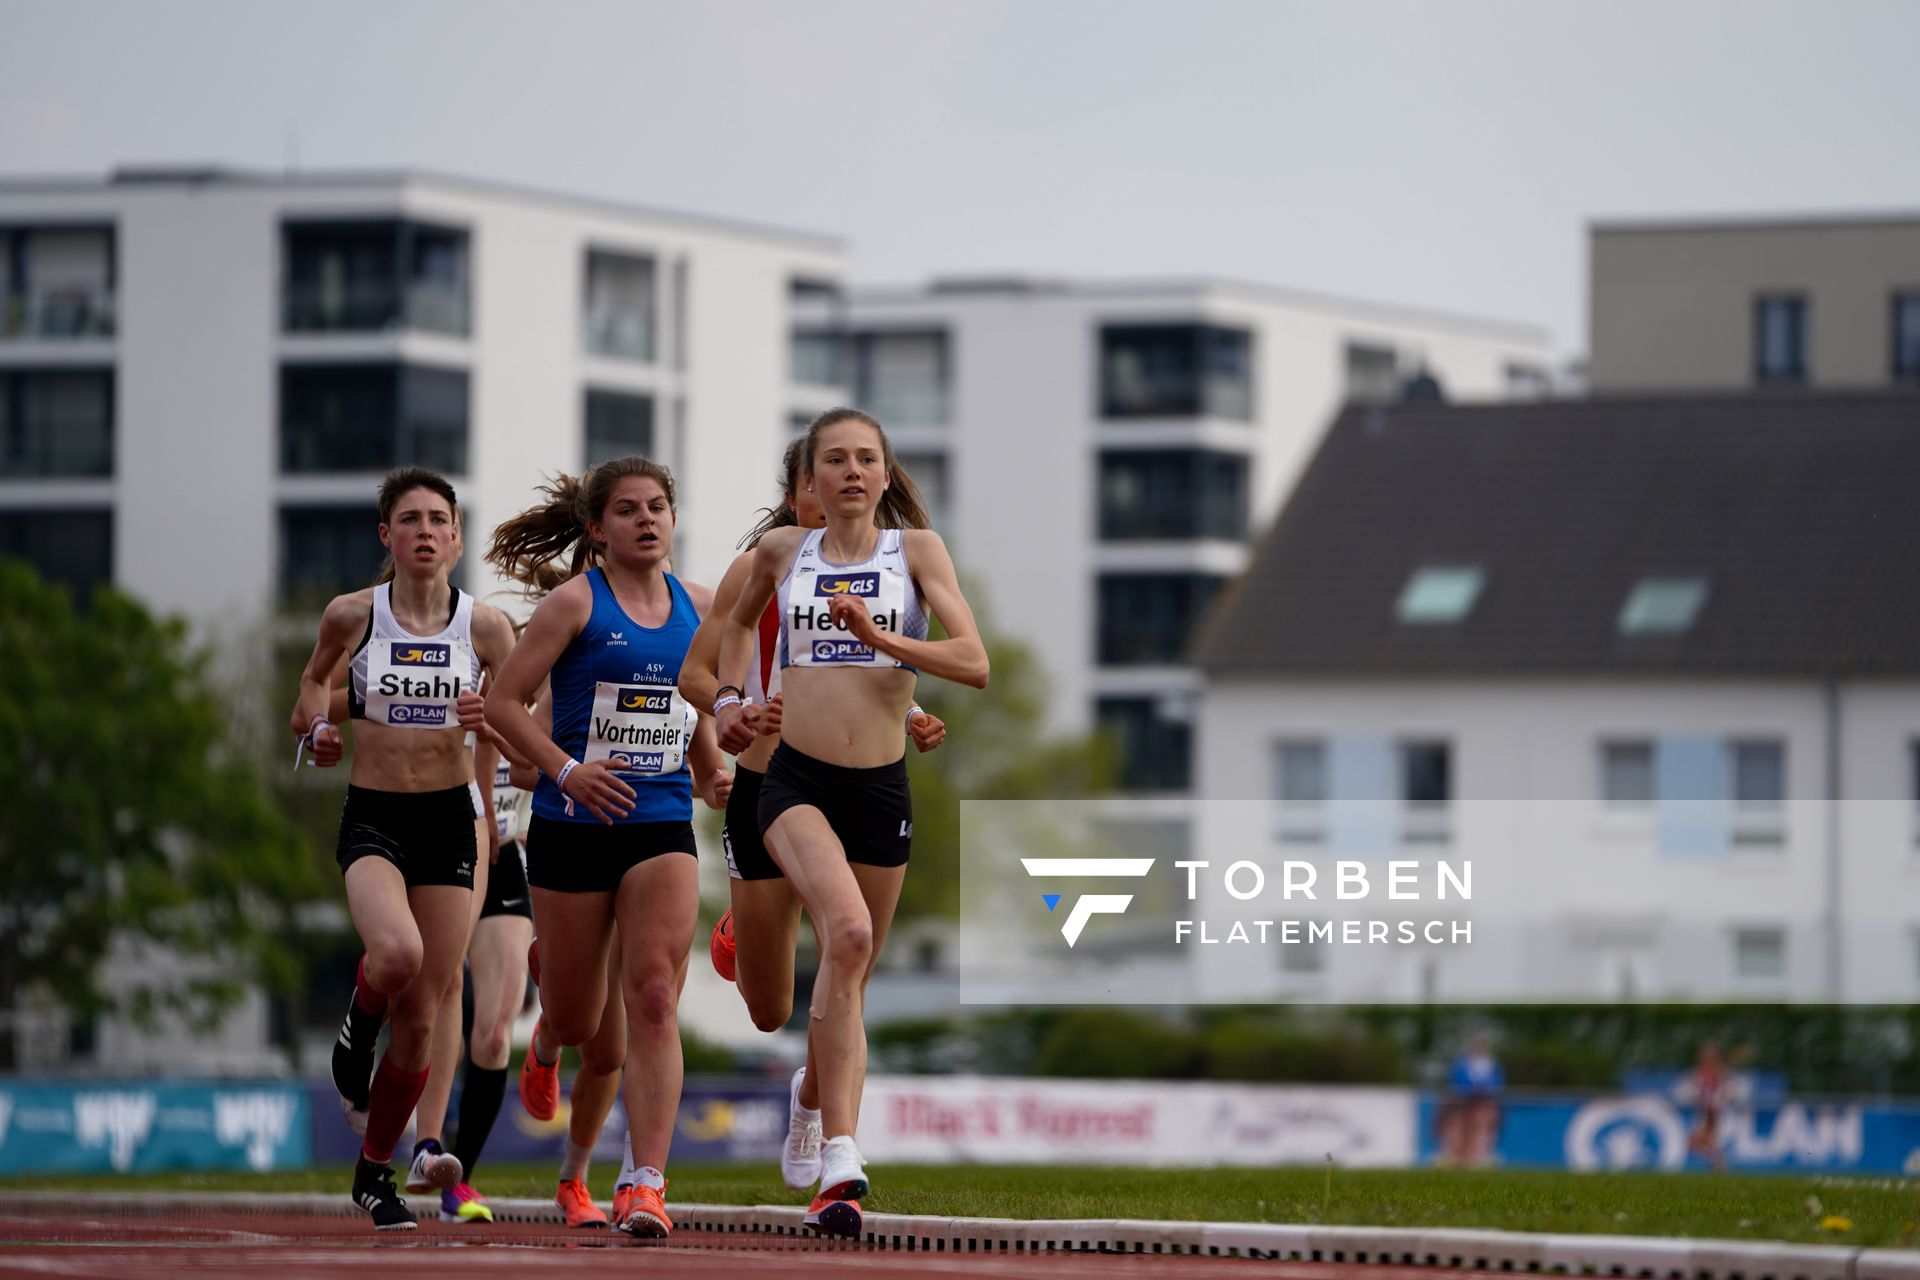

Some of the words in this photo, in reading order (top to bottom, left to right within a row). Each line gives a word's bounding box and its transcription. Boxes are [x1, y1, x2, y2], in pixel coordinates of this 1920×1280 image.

[849, 579, 875, 594] GLS
[793, 605, 897, 632] Heel
[422, 650, 447, 663] GLS
[838, 644, 873, 655] PLAN
[645, 663, 665, 673] ASV
[378, 673, 461, 699] Stahl
[632, 672, 673, 686] Duisburg
[645, 696, 668, 710] GLS
[412, 707, 445, 718] PLAN
[594, 716, 681, 746] Vortmeier
[632, 755, 662, 766] PLAN
